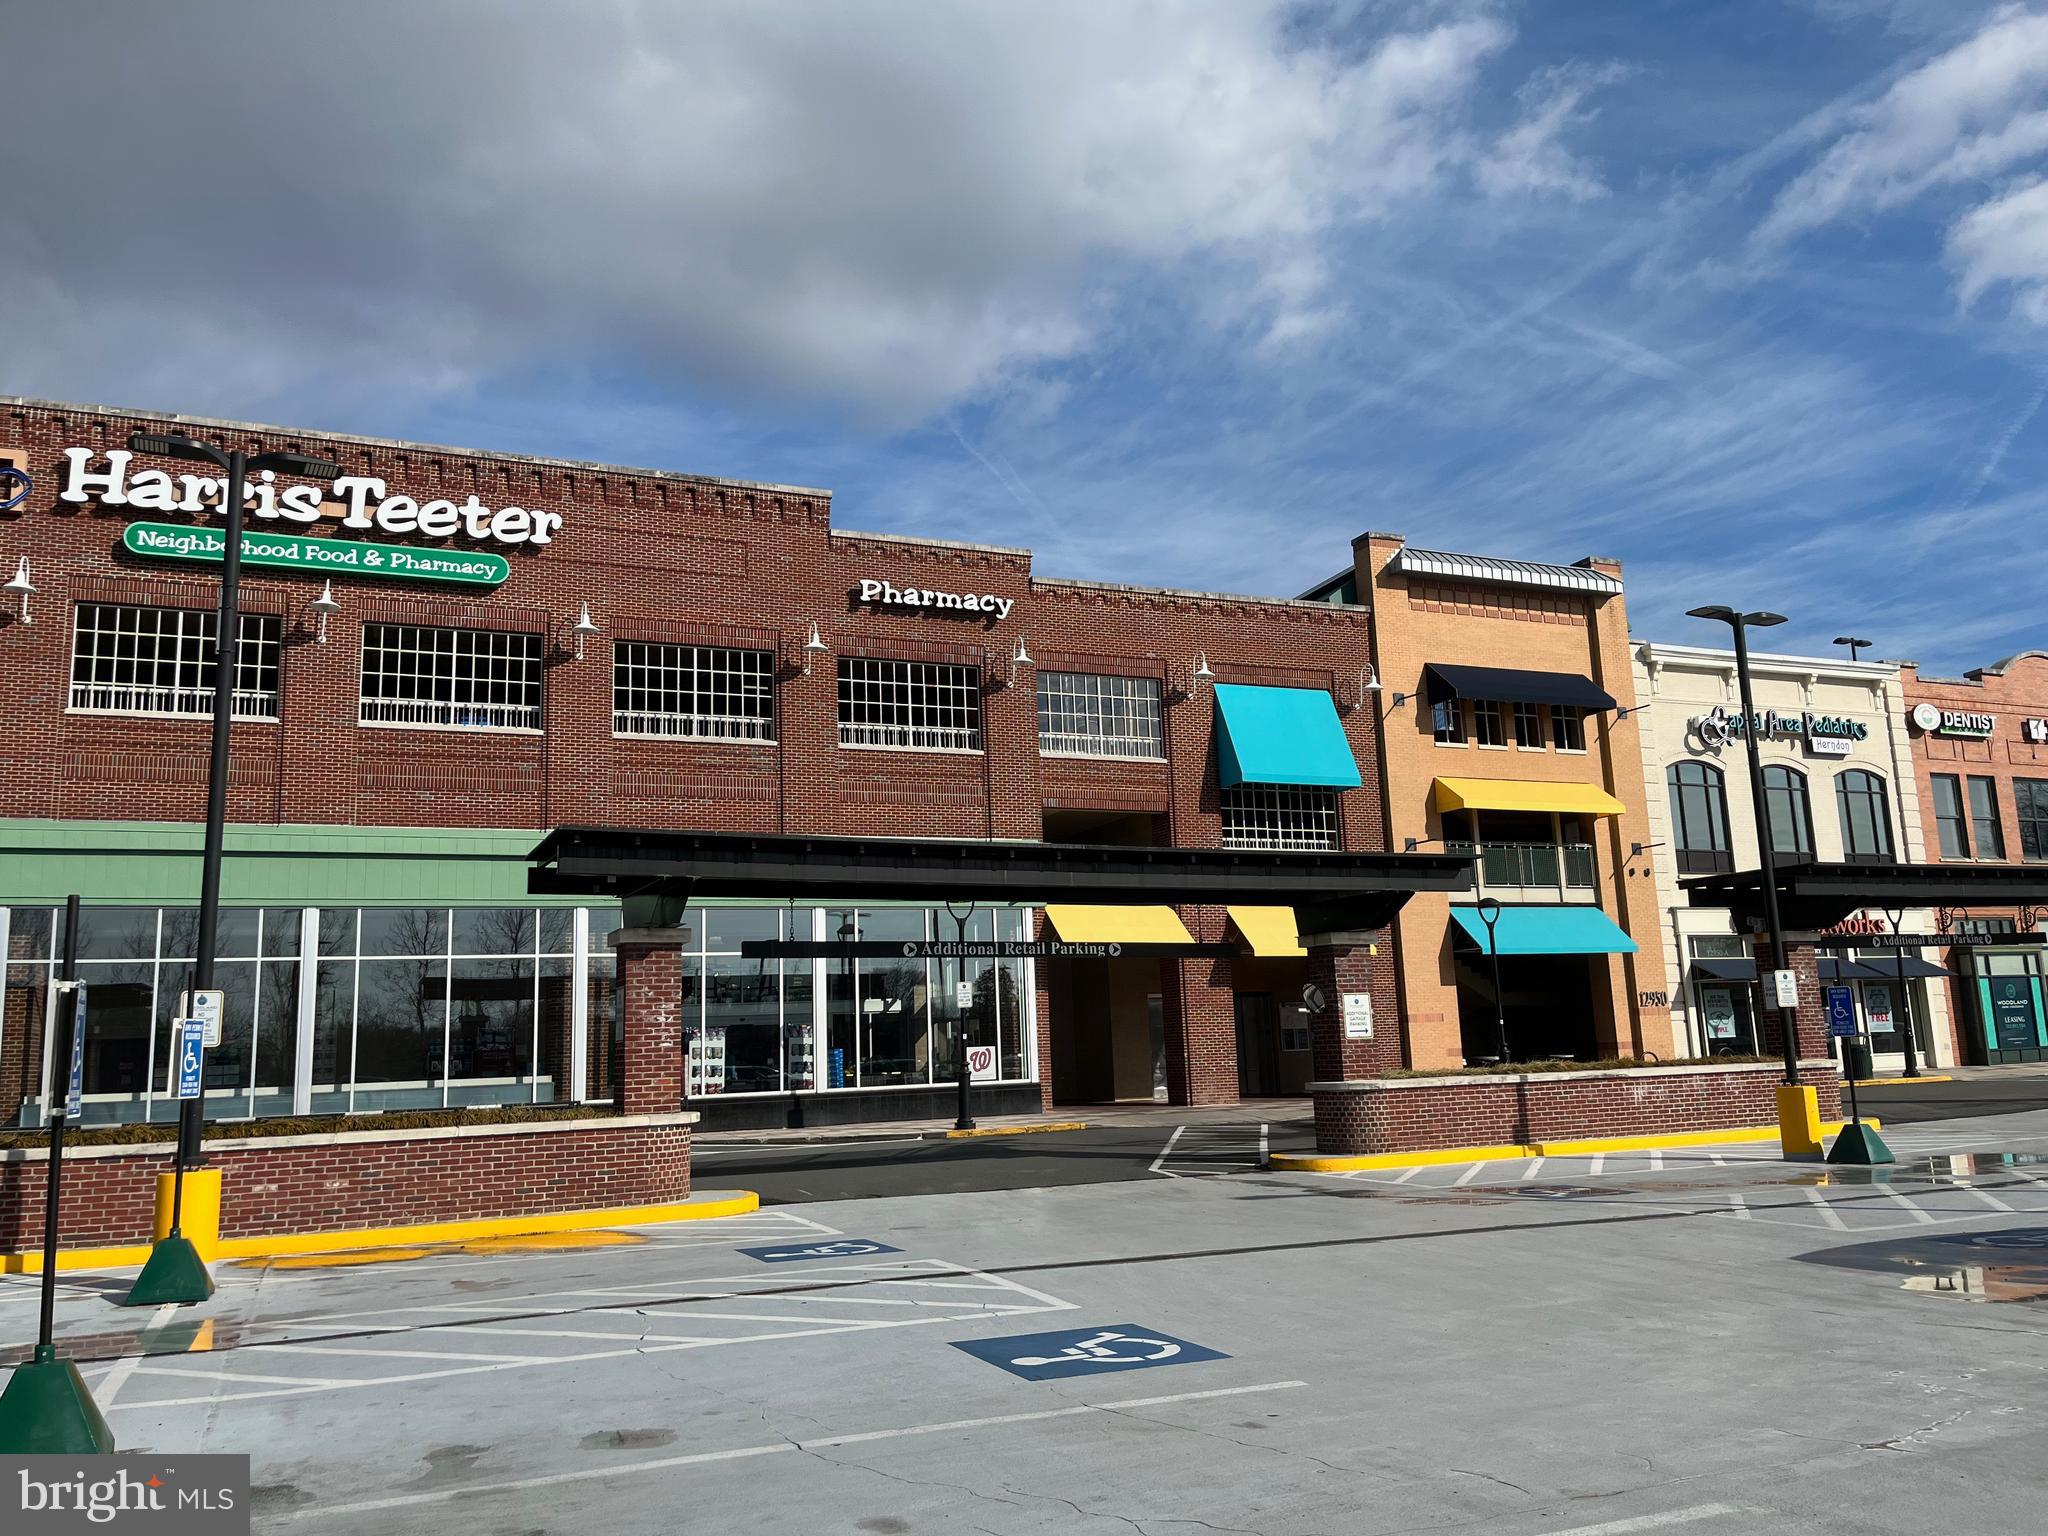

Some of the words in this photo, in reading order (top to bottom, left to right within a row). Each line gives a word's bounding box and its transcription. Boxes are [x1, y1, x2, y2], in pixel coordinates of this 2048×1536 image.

[60, 447, 322, 522] Harris
[333, 476, 563, 544] Teeter
[136, 530, 299, 560] Neighbhood
[304, 545, 358, 566] Food
[364, 550, 385, 567] &
[390, 552, 498, 579] Pharmacy
[859, 579, 1015, 619] Pharmacy
[1701, 705, 1763, 746] Capal
[1768, 708, 1801, 739] Area
[1804, 711, 1869, 741] Pediatrics
[1943, 711, 1998, 731] DENTIST
[1816, 739, 1851, 752] Herndon
[921, 942, 1000, 956] Additional
[1004, 942, 1047, 956] Retail
[1050, 943, 1106, 957] Parking
[1883, 936, 1925, 947] Additional
[1928, 935, 1951, 946] Retail
[1953, 935, 1985, 946] Parking
[1638, 991, 1668, 1007] 12950
[969, 1048, 992, 1073] W
